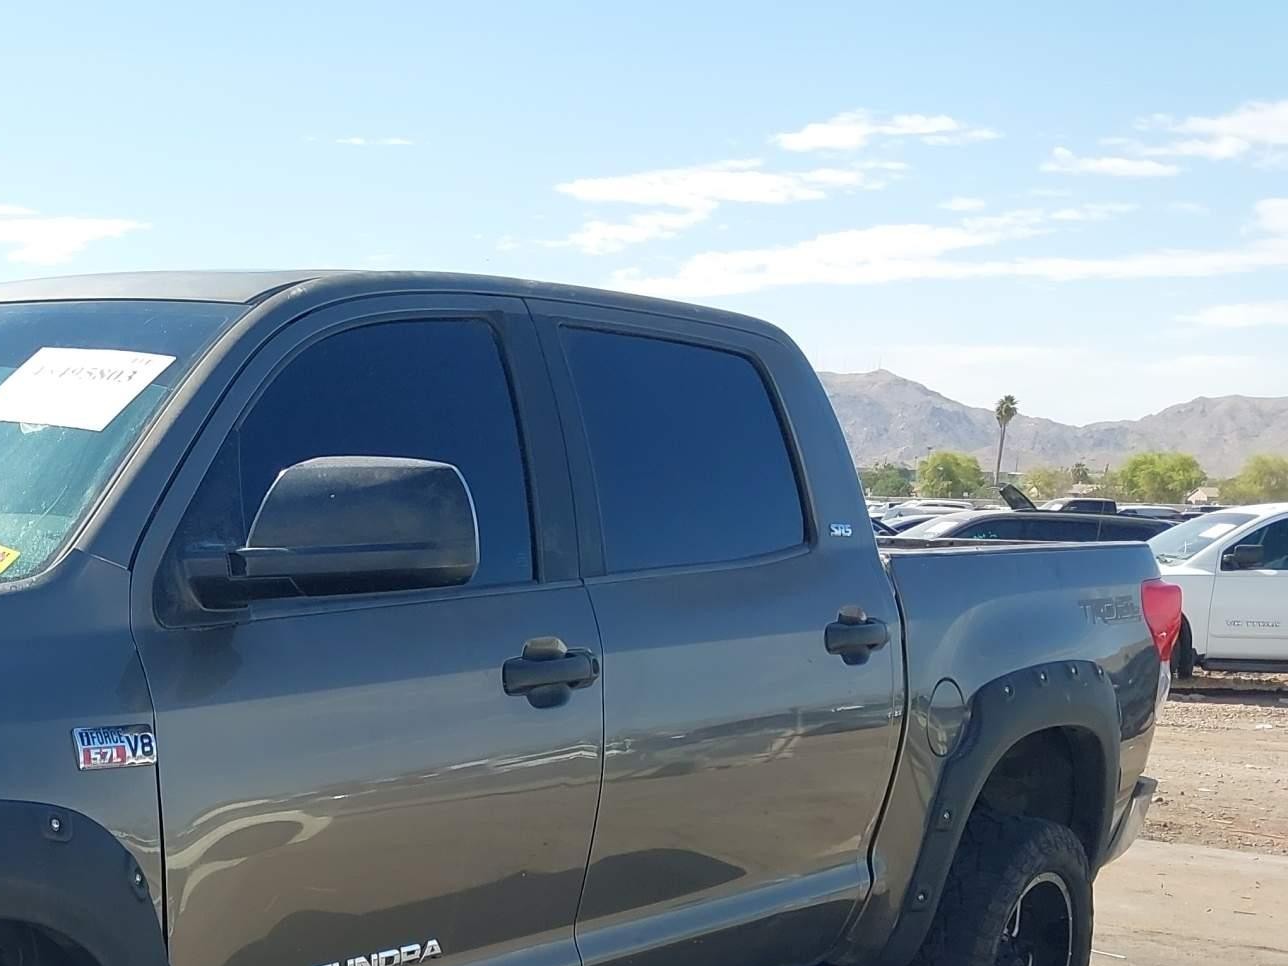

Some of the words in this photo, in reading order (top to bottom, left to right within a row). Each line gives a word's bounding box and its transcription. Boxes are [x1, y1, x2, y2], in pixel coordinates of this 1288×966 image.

[830, 523, 852, 537] SR5
[125, 733, 154, 757] V8
[91, 747, 122, 763] 5.7L
